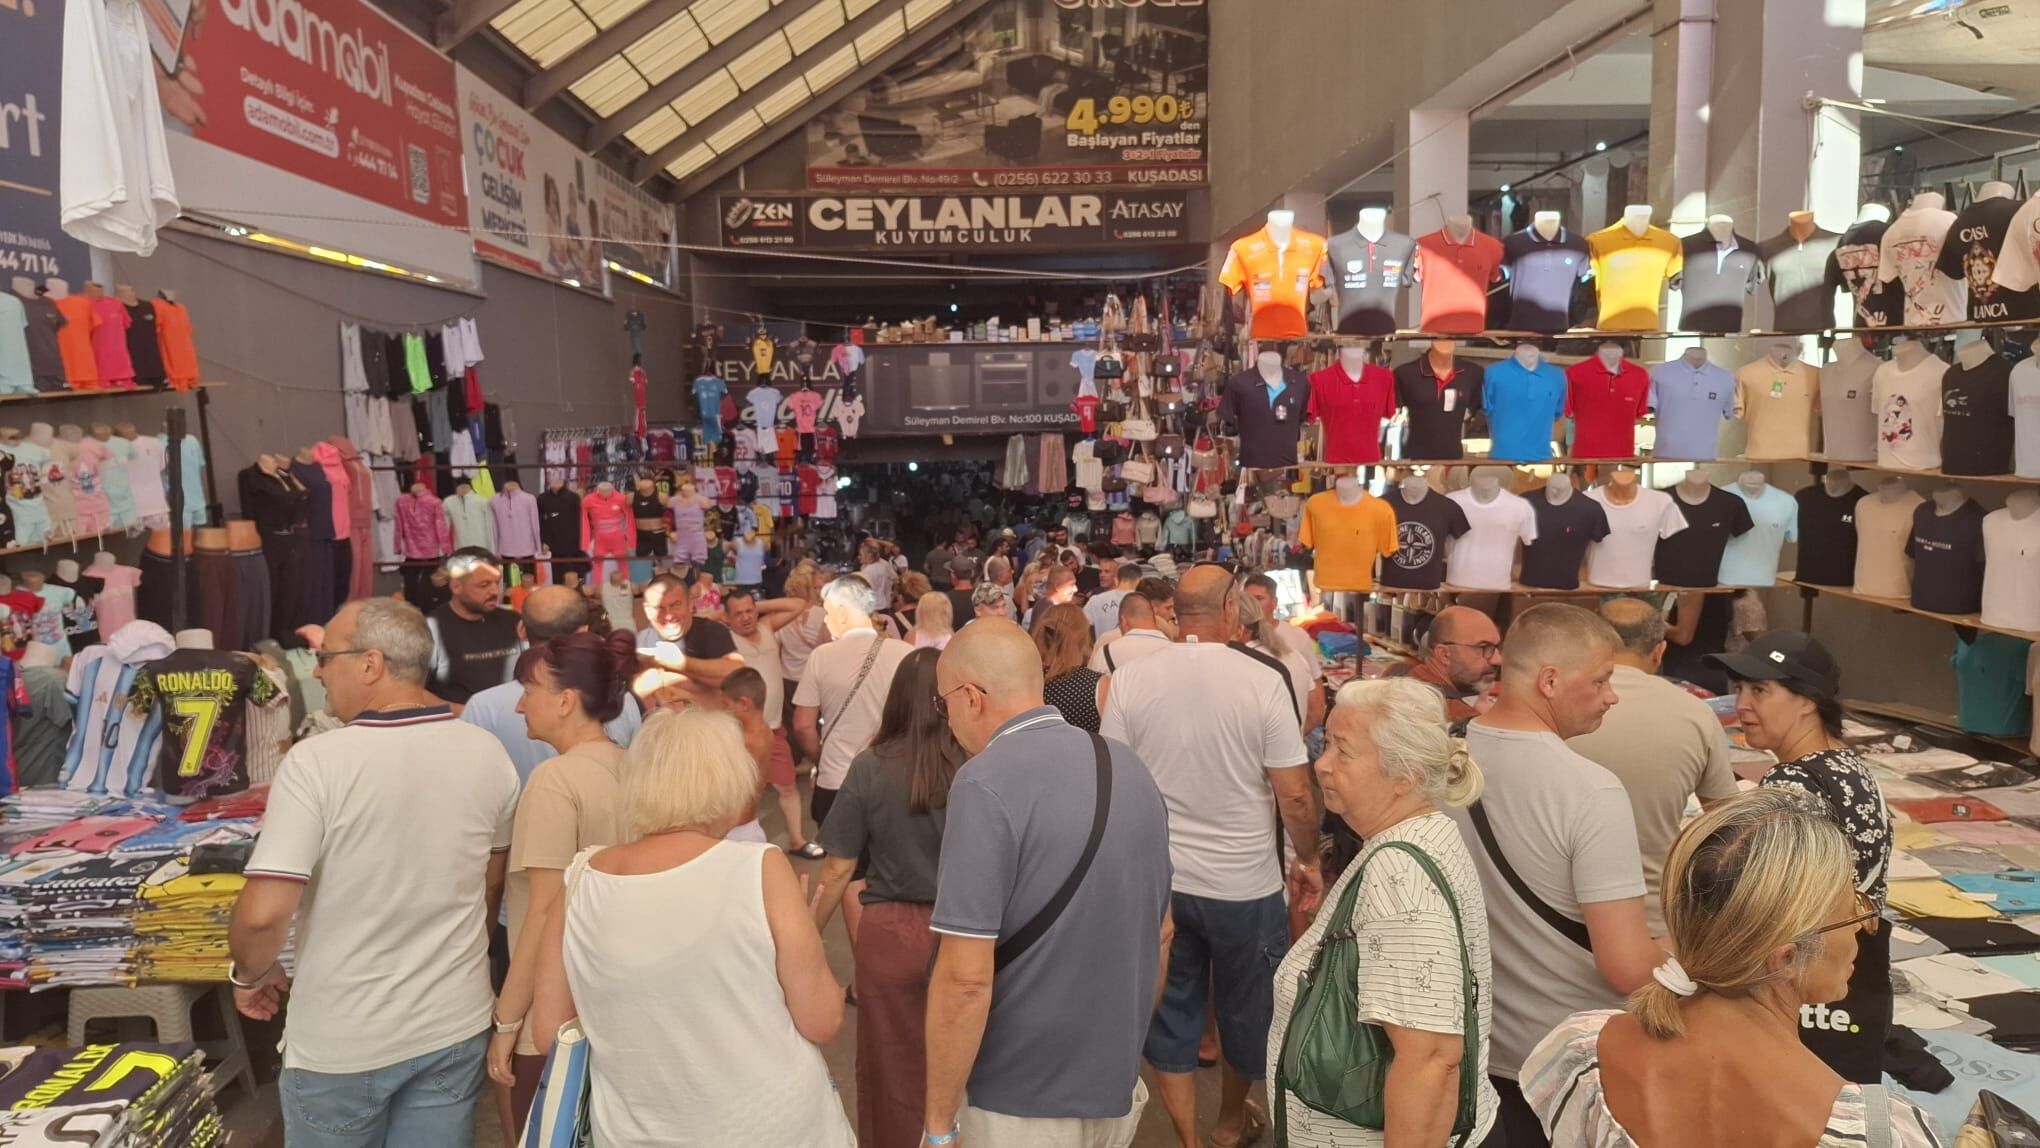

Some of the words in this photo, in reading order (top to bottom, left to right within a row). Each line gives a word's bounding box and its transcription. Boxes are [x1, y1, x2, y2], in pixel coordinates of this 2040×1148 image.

[1066, 134, 1138, 149] Başlayan
[1141, 132, 1201, 148] Fiyatlar
[473, 121, 527, 182] ÇOCUK
[994, 172, 1039, 187] (0256)
[1041, 171, 1069, 185] 622
[1072, 171, 1091, 184] 30
[1094, 171, 1113, 183] 33
[1127, 169, 1203, 185] KUŞADASI
[752, 203, 793, 220] ZEN
[808, 195, 1102, 231] CEYLANLAR
[1108, 199, 1184, 220] ATASAY
[875, 229, 1032, 245] KUYUMCULUK
[1960, 225, 1989, 243] CASA
[21, 252, 39, 273] 71
[40, 255, 59, 276] 14
[904, 415, 950, 427] Süleyman
[952, 415, 989, 425] Demirel
[991, 414, 1008, 424] Blv.
[1009, 413, 1042, 424] No:100
[157, 671, 233, 692] RONALDO
[175, 696, 219, 777] 7
